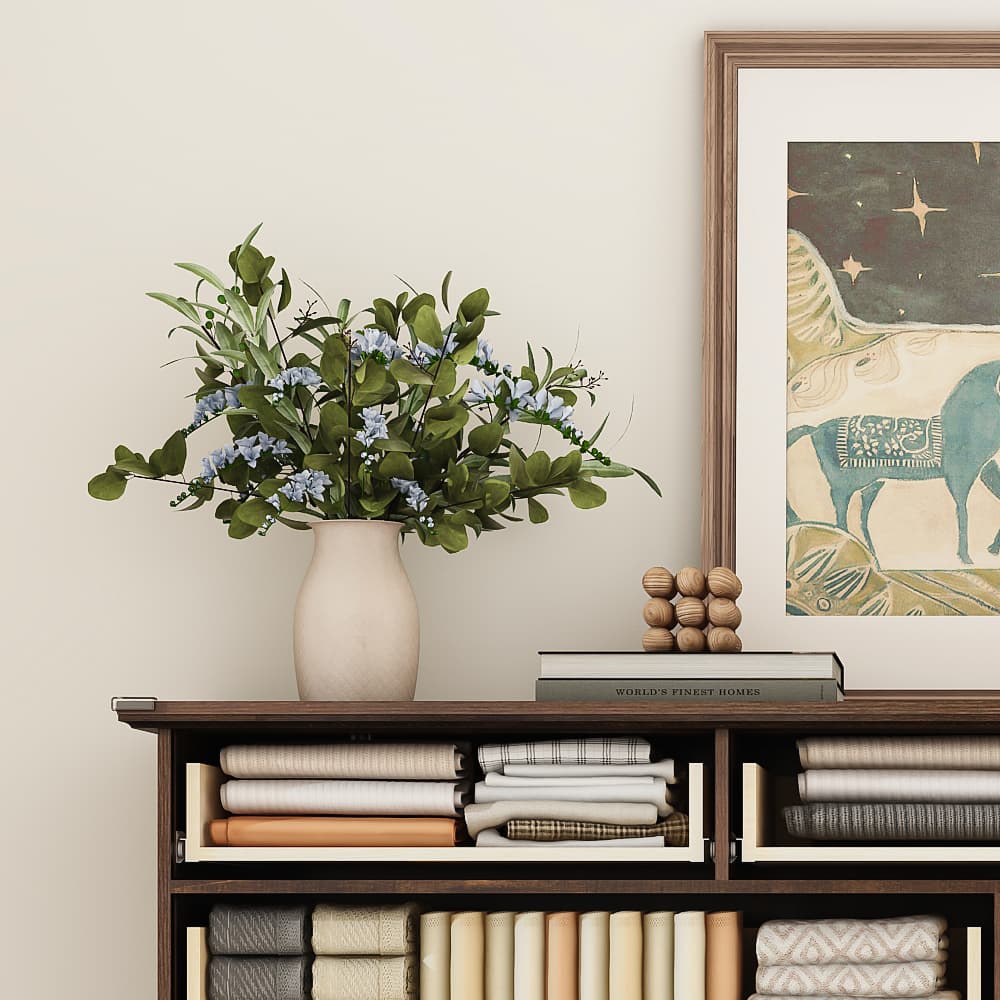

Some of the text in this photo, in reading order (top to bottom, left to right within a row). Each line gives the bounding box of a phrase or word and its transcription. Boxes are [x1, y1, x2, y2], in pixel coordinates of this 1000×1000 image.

[615, 688, 761, 696] WORLD'S FINEST HOMES
